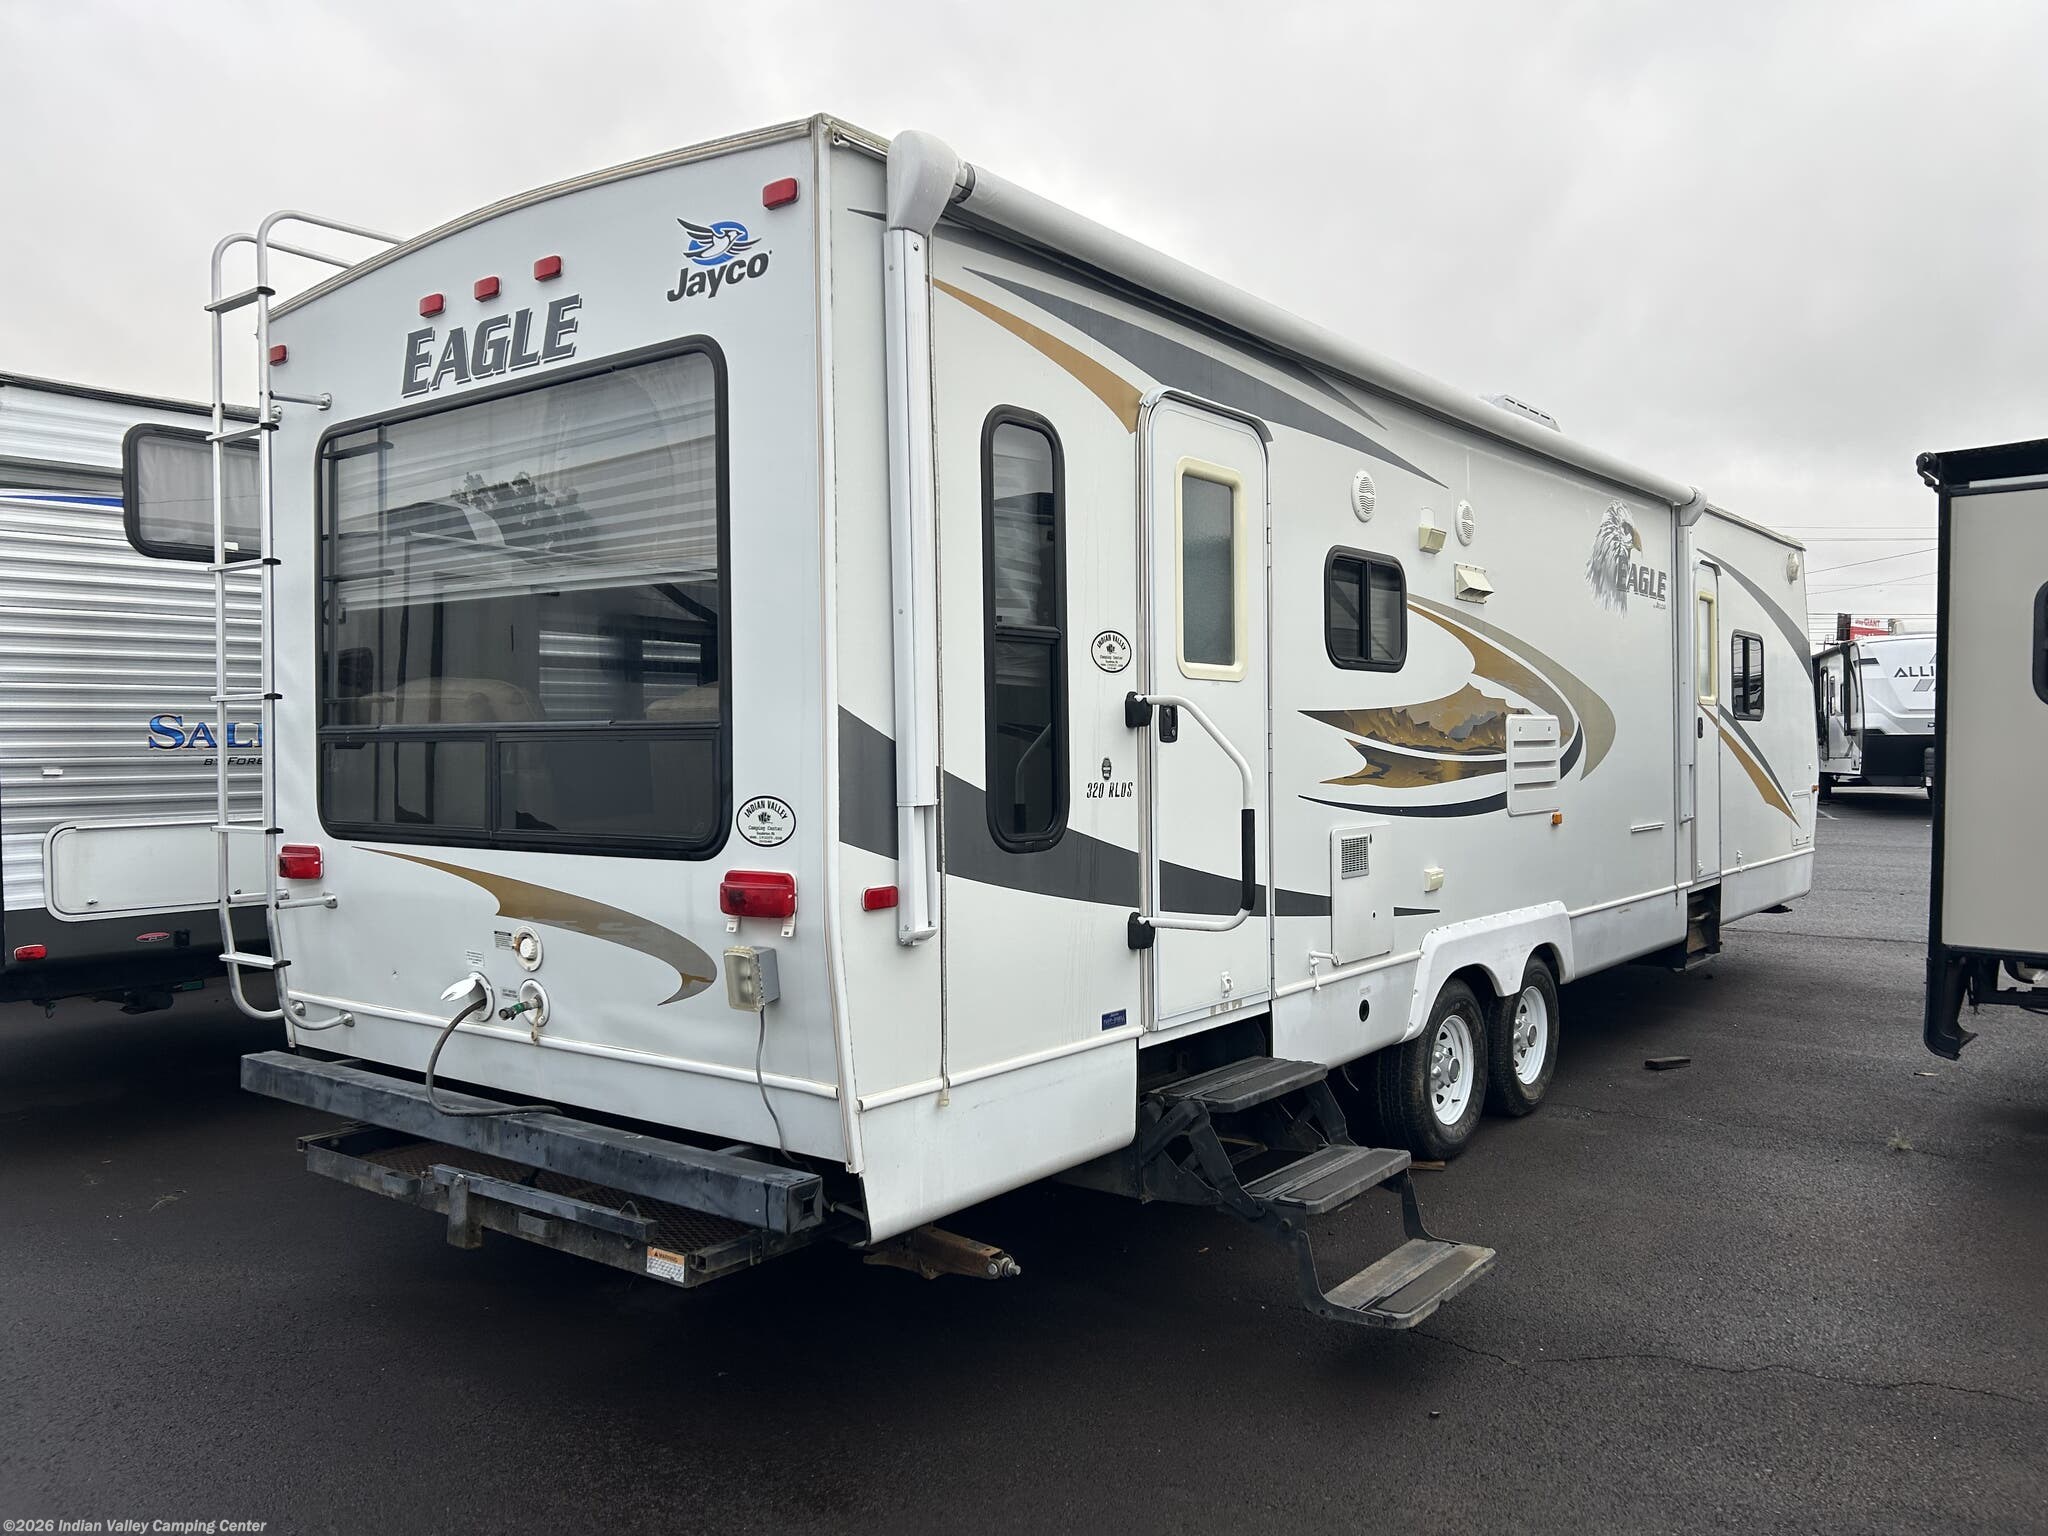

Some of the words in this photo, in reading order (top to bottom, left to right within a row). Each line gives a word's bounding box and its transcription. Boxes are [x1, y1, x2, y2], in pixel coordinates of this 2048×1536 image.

[666, 252, 769, 302] Jayco
[401, 293, 582, 398] EAGLE
[1616, 555, 1667, 602] EAGLE
[744, 800, 766, 818] INDIAN
[767, 800, 788, 820] VALLEY
[1086, 782, 1105, 799] 320
[1108, 781, 1133, 798] RLDS
